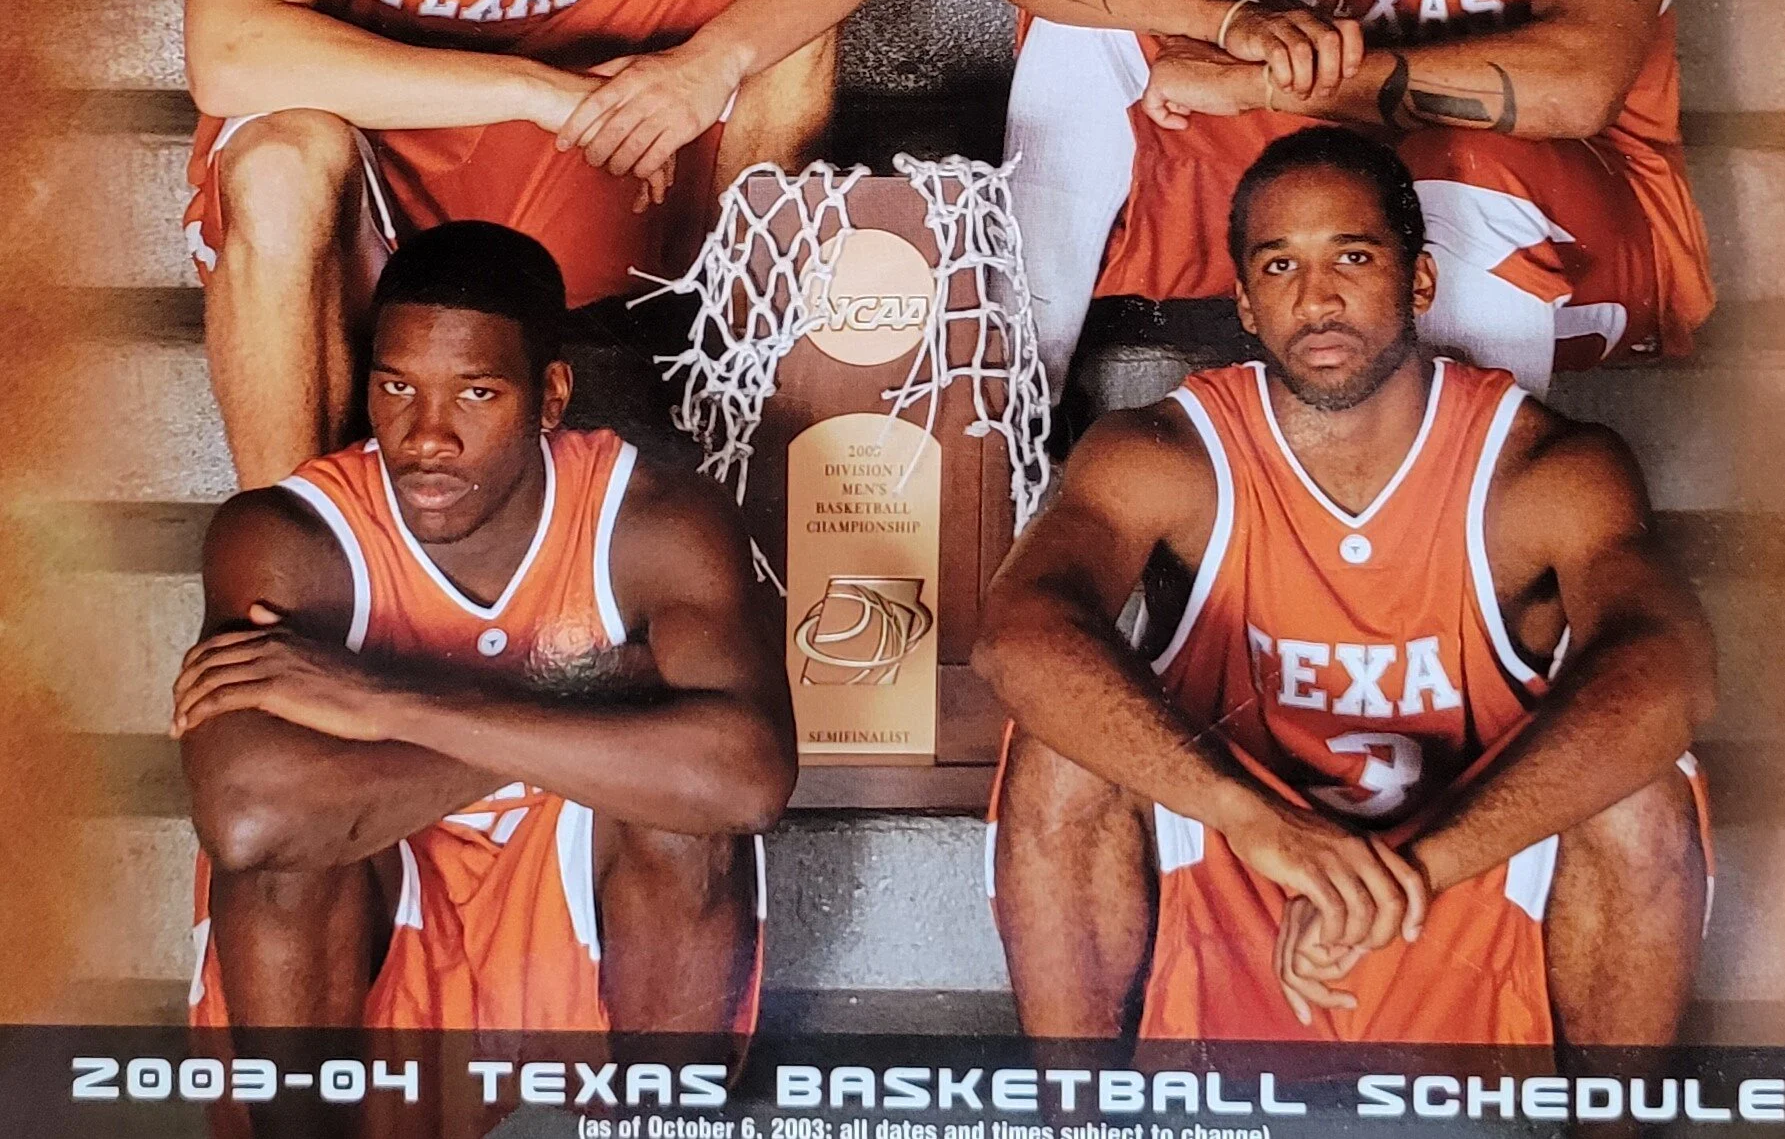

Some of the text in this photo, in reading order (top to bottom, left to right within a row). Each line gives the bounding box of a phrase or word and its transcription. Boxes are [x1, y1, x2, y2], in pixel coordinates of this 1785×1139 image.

[811, 296, 929, 331] NCAA
[825, 464, 892, 476] DIVISION
[816, 502, 911, 514] BASKETBALL
[806, 521, 920, 533] CHAMPIONSHIP
[808, 731, 910, 743] SEMIFINALIST
[72, 1057, 1785, 1121] 2003-04 TEXAS BASKETBALL SCHEDULE
[579, 1114, 612, 1139] (as
[618, 1115, 642, 1139] of
[648, 1115, 735, 1139] October
[840, 1118, 868, 1139] all
[875, 1119, 938, 1139] dates
[944, 1120, 985, 1139] and
[991, 1120, 1054, 1139] times
[1150, 1123, 1174, 1139] to
